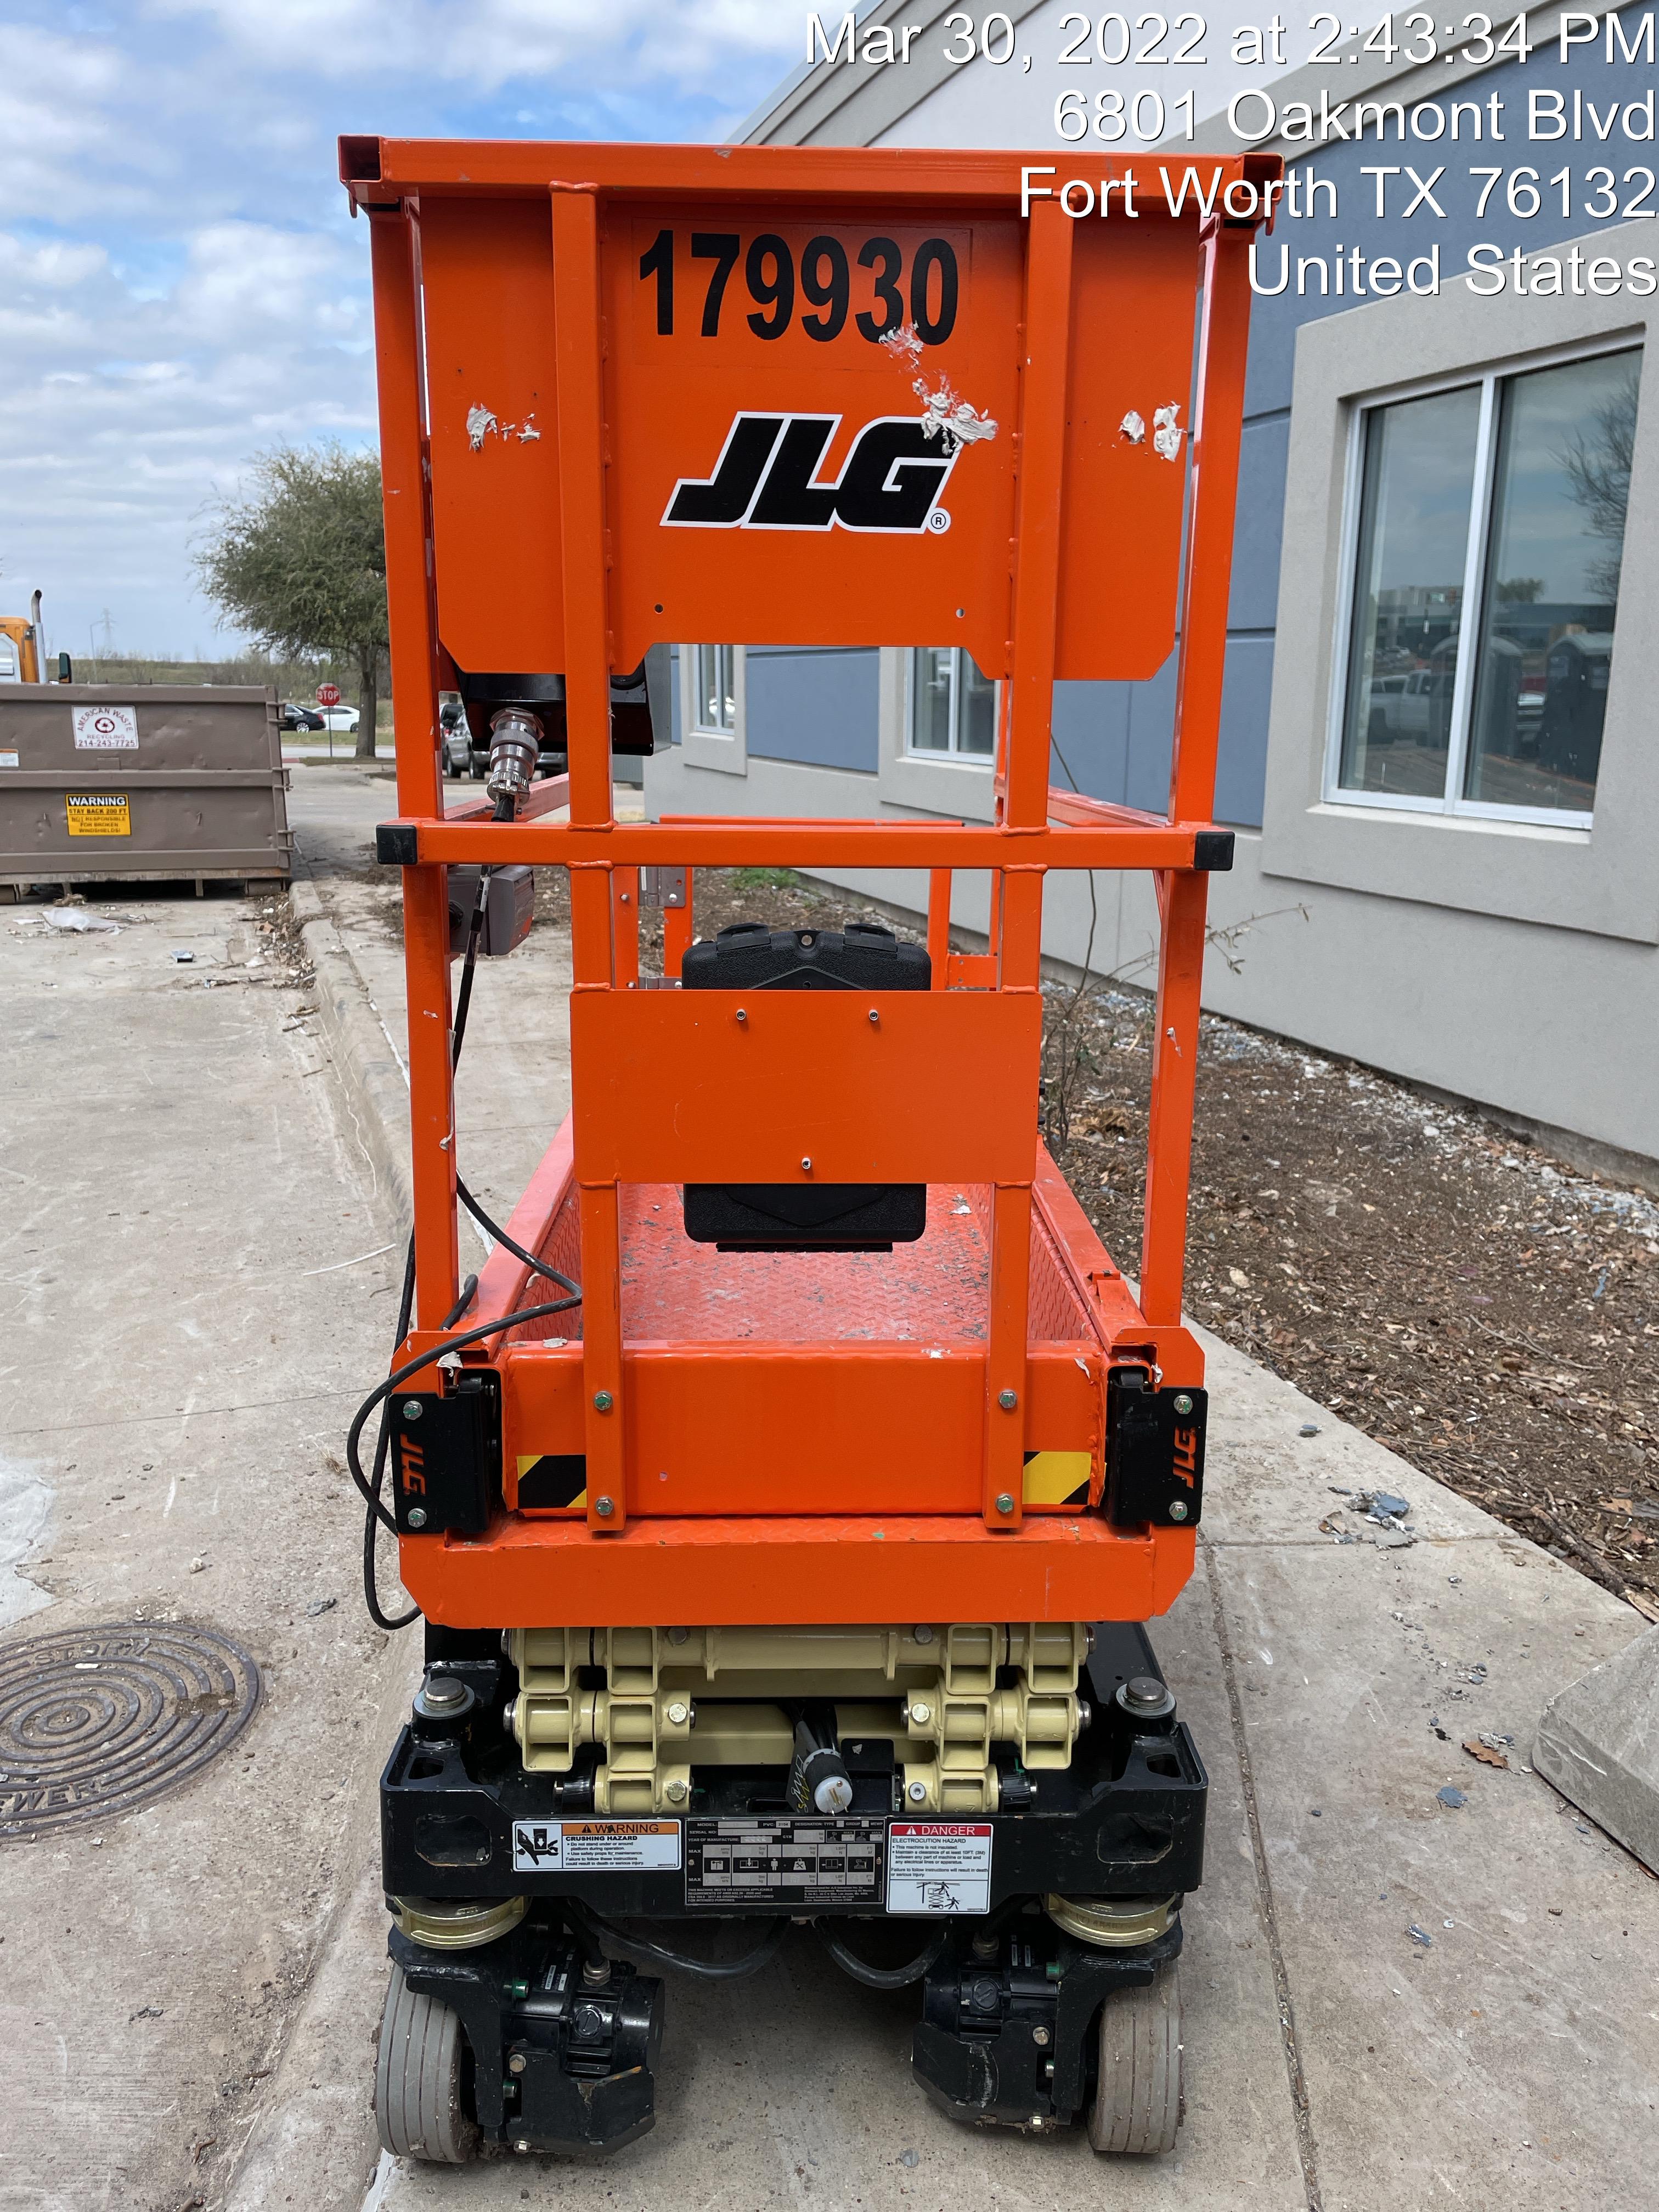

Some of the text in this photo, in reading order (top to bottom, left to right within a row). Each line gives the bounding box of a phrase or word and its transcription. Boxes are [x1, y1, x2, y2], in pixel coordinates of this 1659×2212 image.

[639, 229, 958, 346] 179930
[659, 411, 964, 533] JLG
[318, 690, 338, 701] STOP
[77, 707, 133, 732] AMERICAN WASTE
[69, 797, 125, 806] WARNING
[400, 1433, 426, 1496] JLG
[1173, 1426, 1198, 1490] JLG
[595, 1824, 659, 1833] WARNING
[922, 1826, 975, 1835] DANGER
